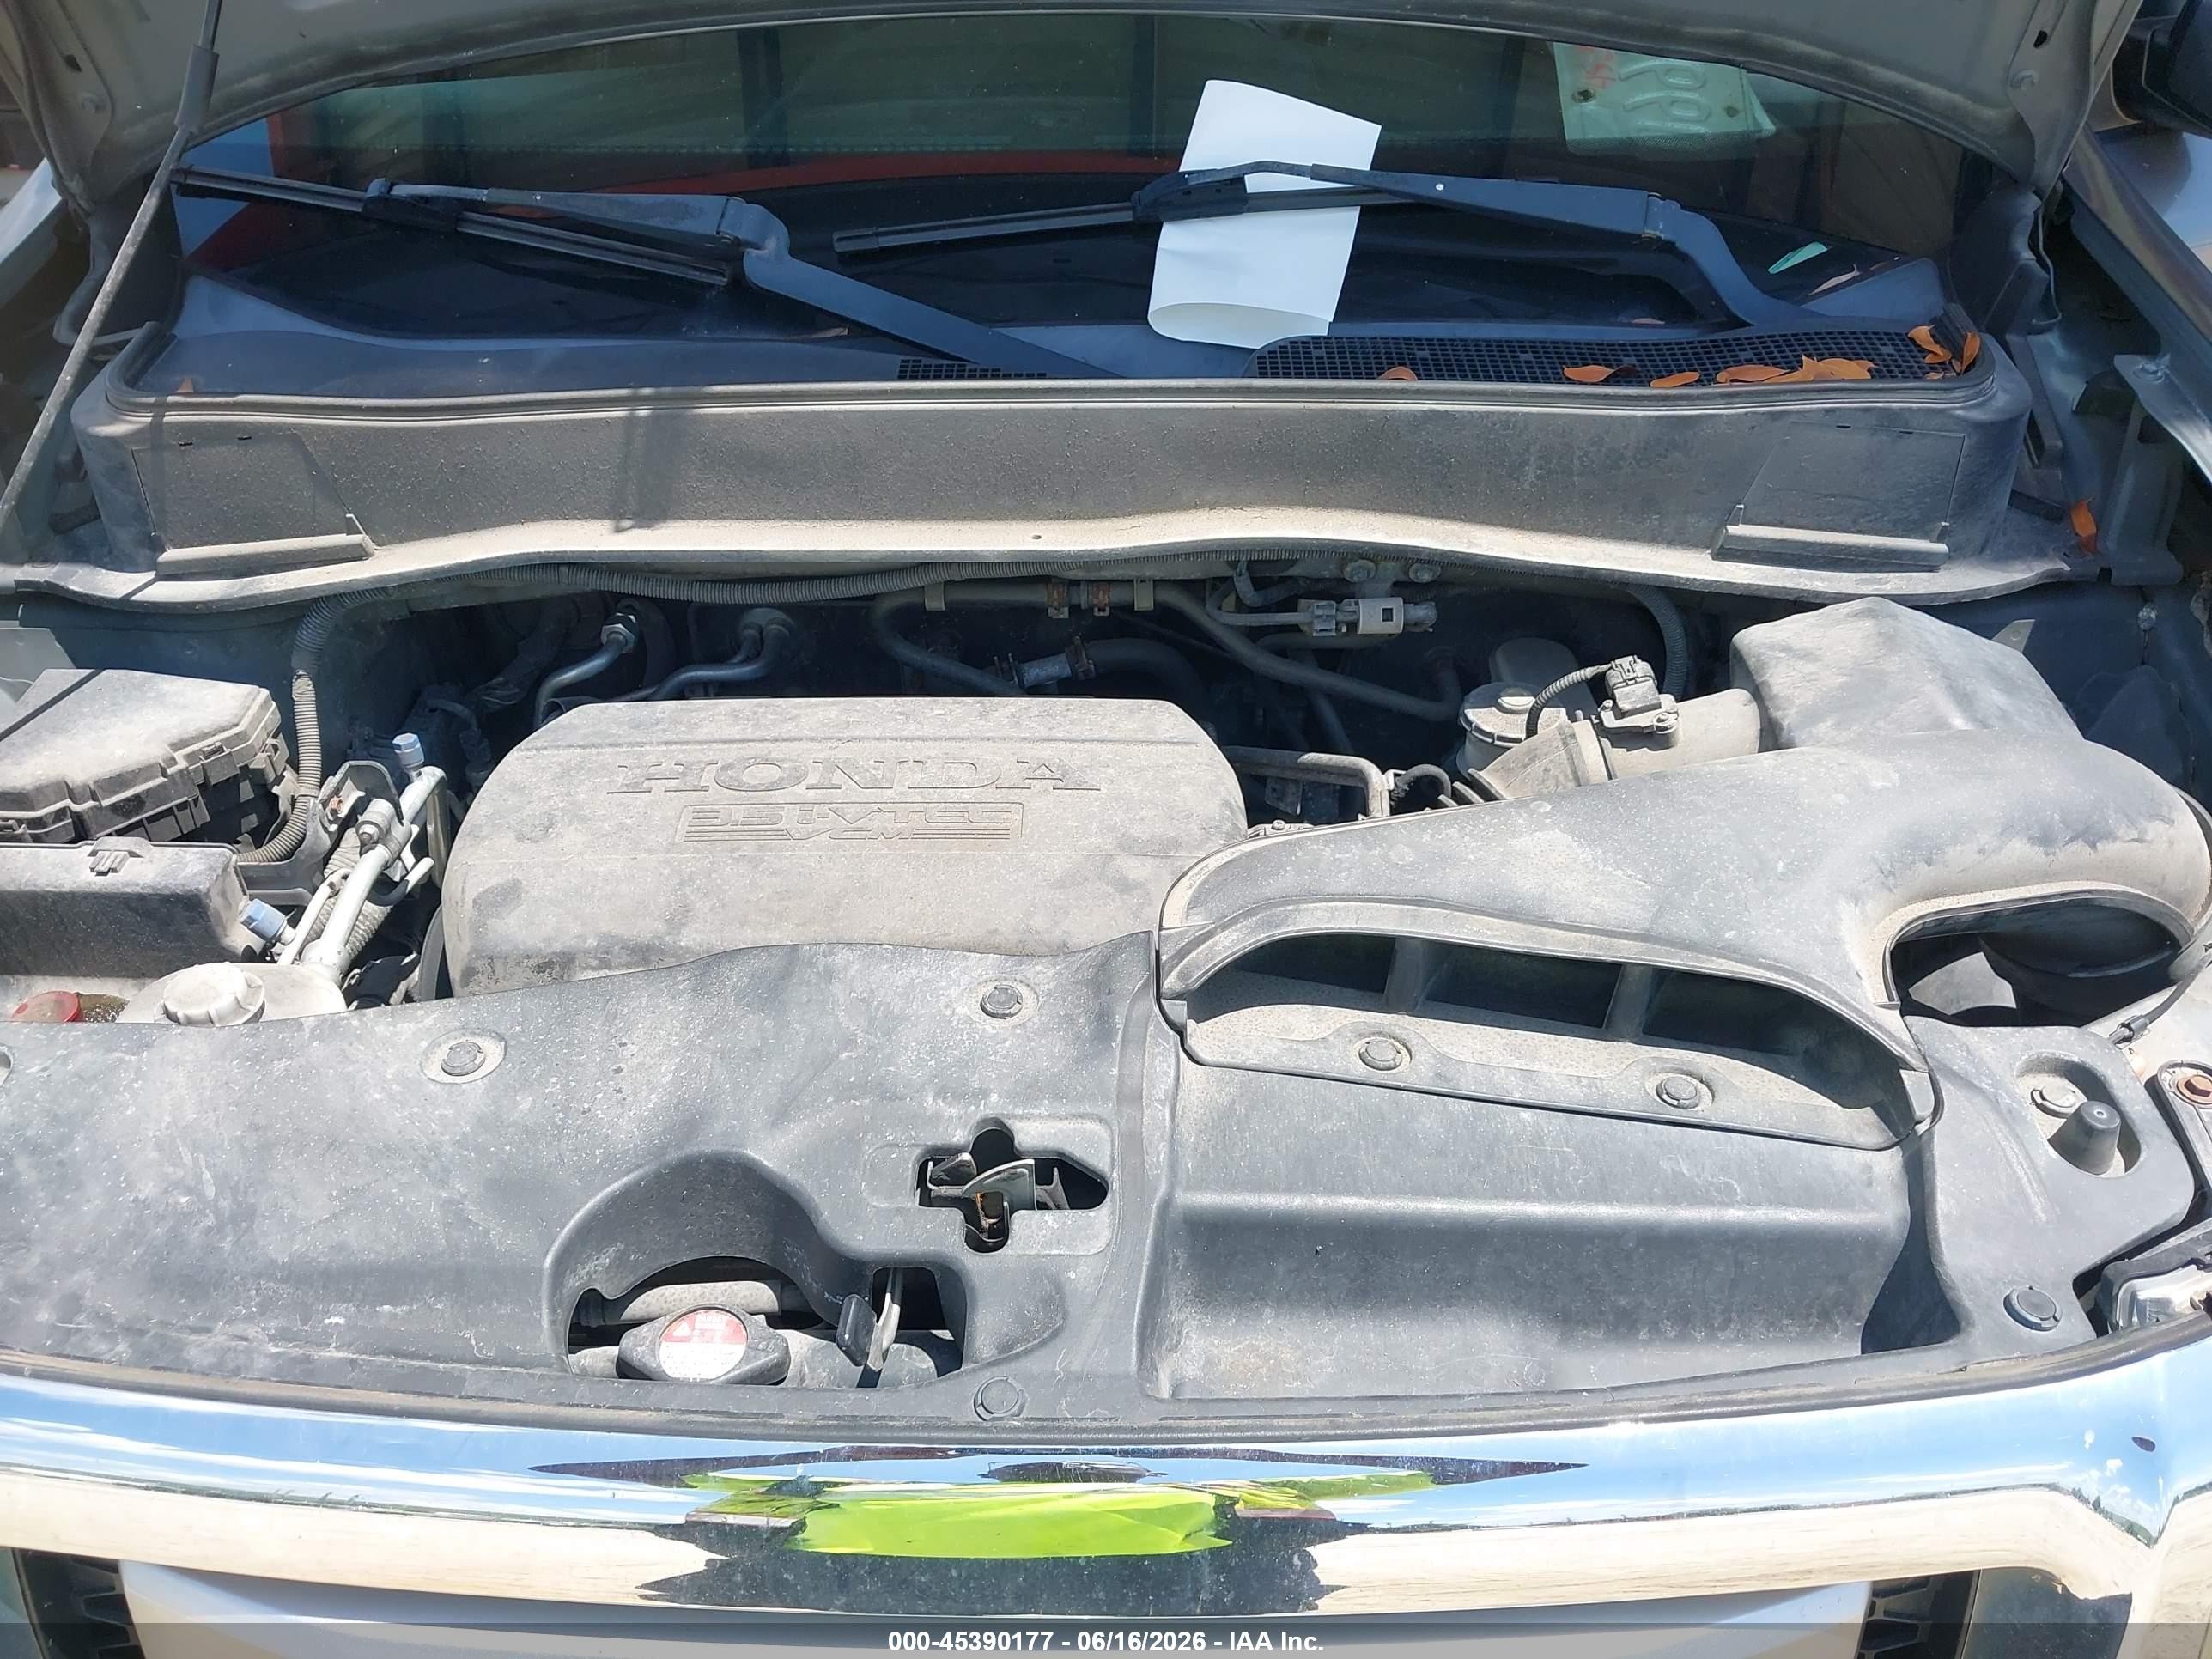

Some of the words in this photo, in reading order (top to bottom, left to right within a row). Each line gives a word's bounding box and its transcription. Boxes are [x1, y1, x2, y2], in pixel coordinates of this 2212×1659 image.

[607, 757, 1101, 793] HONDA
[687, 806, 784, 827] 3.5
[795, 805, 1012, 825] i-VTEC
[783, 825, 918, 841] VCM
